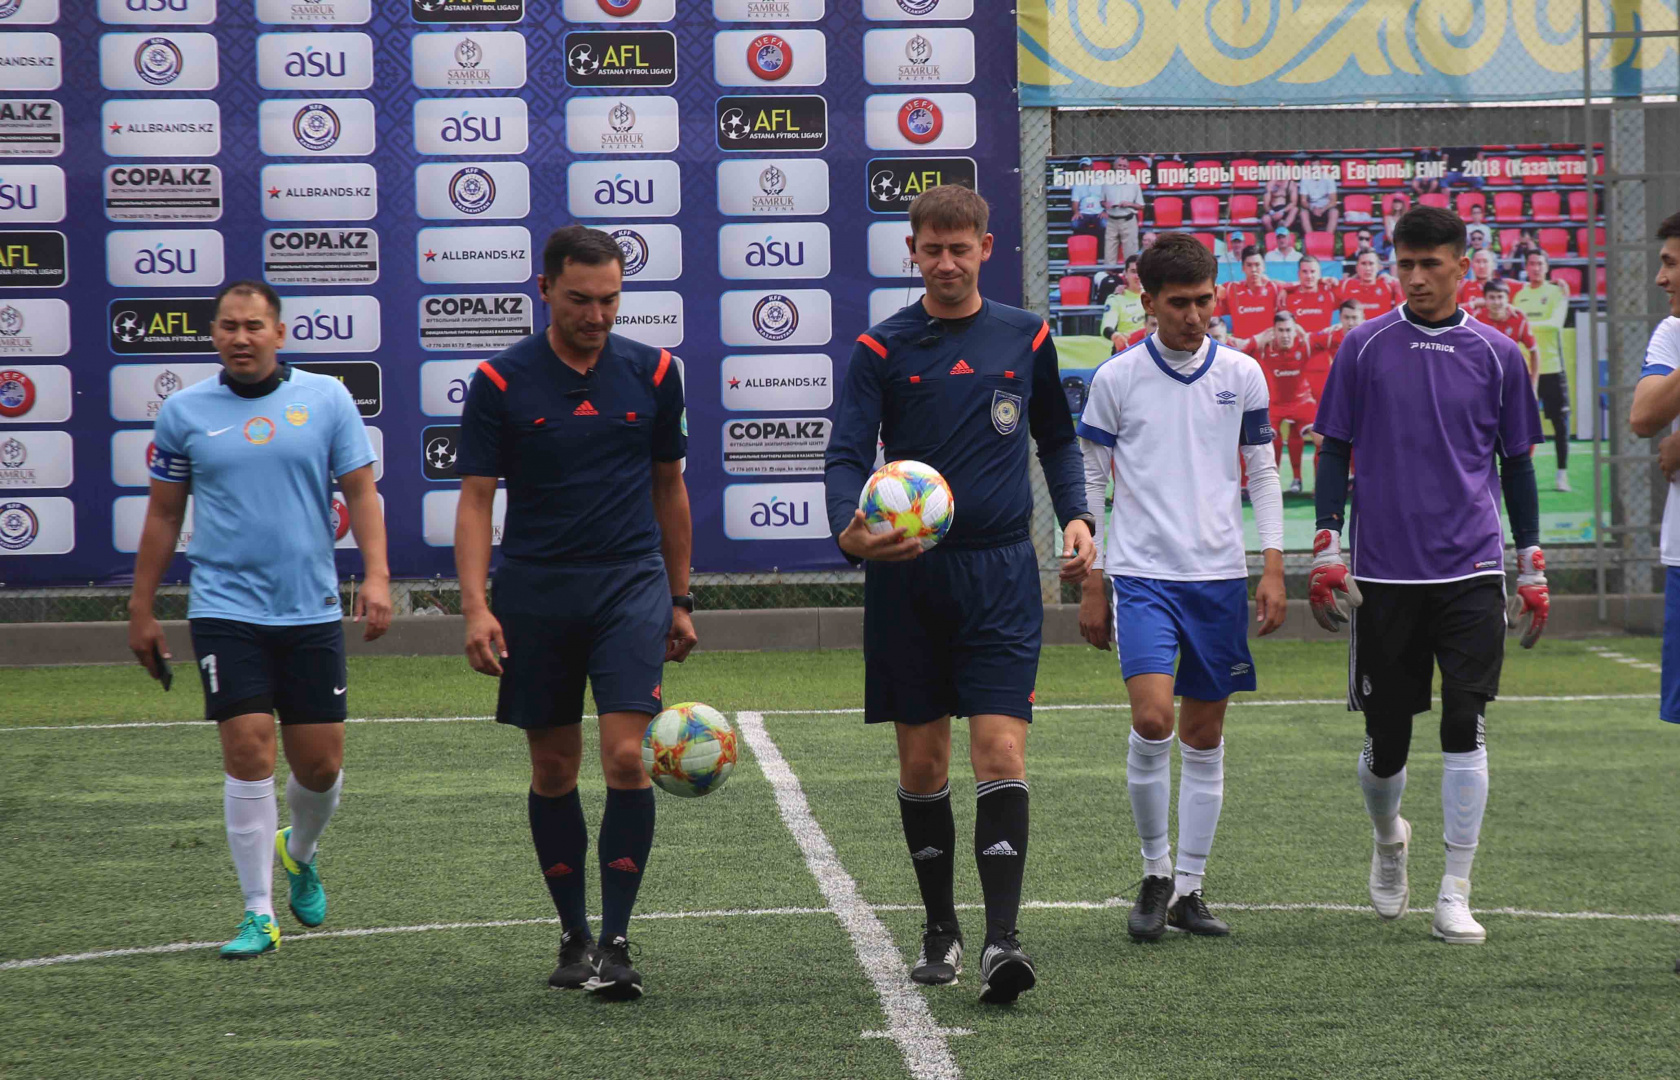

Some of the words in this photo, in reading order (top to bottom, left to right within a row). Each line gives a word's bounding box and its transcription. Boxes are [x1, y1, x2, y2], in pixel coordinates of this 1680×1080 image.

[291, 5, 334, 15] SAMRUK
[748, 3, 789, 12] SAMRUK
[755, 37, 783, 48] UEFA
[603, 45, 649, 67] AFL
[448, 69, 490, 79] SAMRUK
[898, 66, 940, 76] SAMRUK
[905, 100, 933, 112] UEFA
[754, 109, 800, 131] AFL
[127, 122, 214, 133] ALLBRANDS.KZ
[601, 133, 643, 144] SAMRUK
[801, 131, 823, 139] LIGASY
[111, 168, 211, 186] COPA.KZ
[1053, 167, 1151, 190] Бронзовые
[1157, 164, 1235, 185] призеры
[1238, 162, 1340, 182] чемпионата
[1346, 161, 1411, 182] Европы
[1416, 160, 1447, 178] EMF
[1462, 160, 1500, 178] 2018
[286, 187, 371, 197] ALLBRANDS.KZ
[752, 196, 794, 206] SAMRUK
[454, 201, 491, 214] KAZAKHSTAN
[270, 232, 368, 249] COPA.KZ
[441, 250, 525, 260] ALLBRANDS.KZ
[425, 298, 522, 315] COPA.KZ
[149, 312, 197, 334] AFL
[615, 315, 677, 324] BRANDS.KZ
[758, 328, 794, 341] KAZAKHSTAN
[1420, 342, 1455, 353] PATRICK
[745, 377, 827, 388] ALLBRANDS.KZ
[729, 422, 824, 440] COPA.KZ
